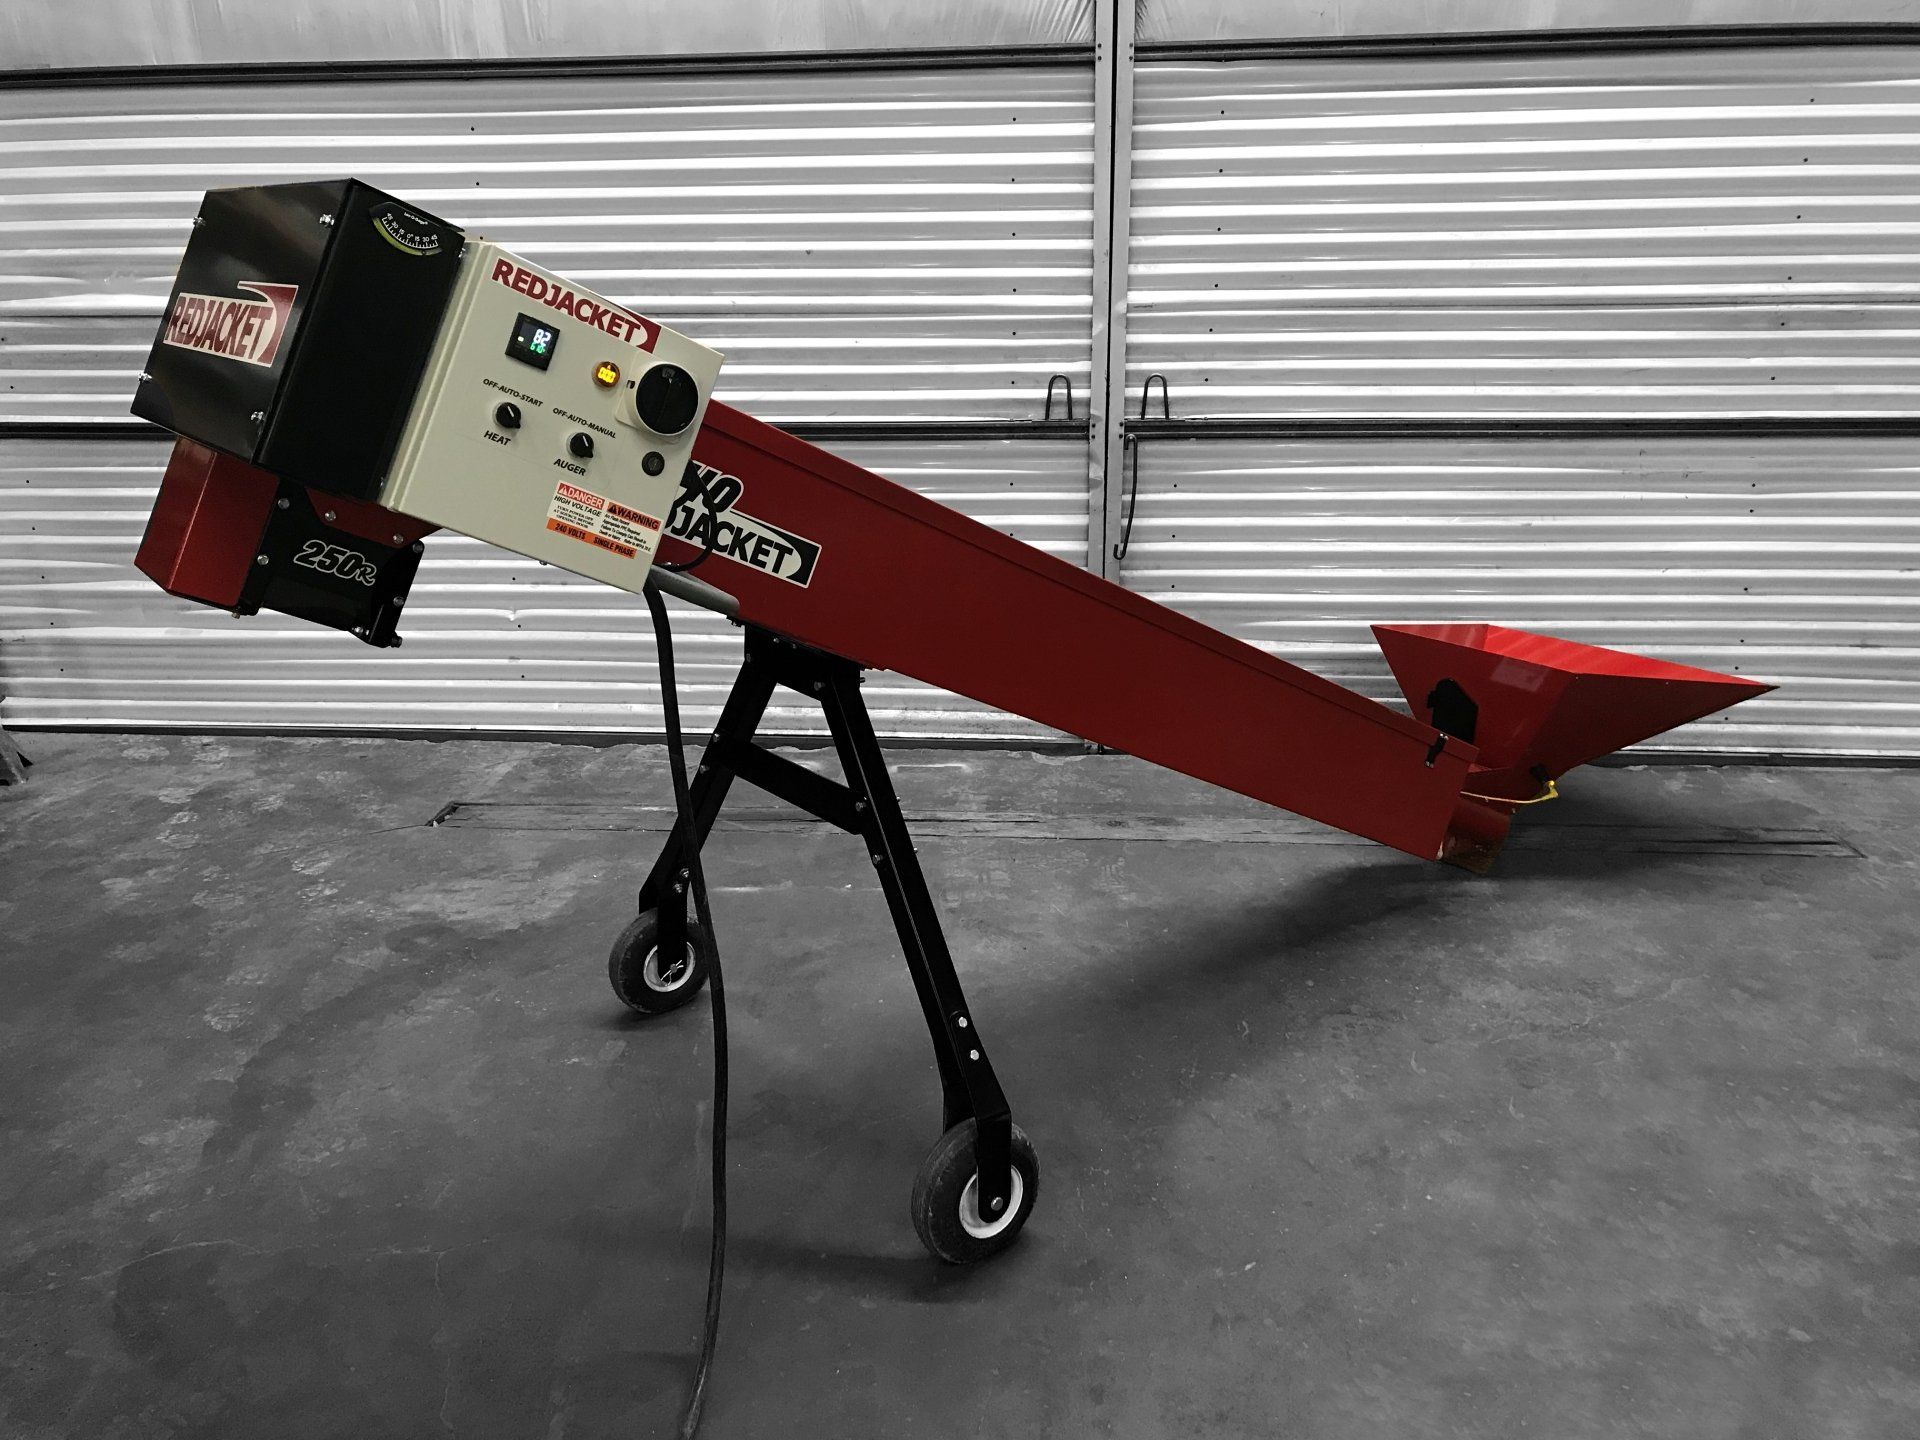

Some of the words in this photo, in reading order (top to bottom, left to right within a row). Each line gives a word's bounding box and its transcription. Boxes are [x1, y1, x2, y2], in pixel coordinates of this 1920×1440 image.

[391, 221, 399, 229] 30
[491, 257, 642, 344] REDJACKET
[165, 296, 274, 360] REDJACKET
[533, 328, 552, 347] 82
[482, 378, 544, 408] OFF-AUTO-START
[552, 407, 617, 440] OFF-AUTO-MANUAL
[483, 430, 512, 447] HEAT
[553, 458, 587, 477] AUGER
[553, 495, 572, 506] HIGH
[571, 501, 603, 518] VOLTAGE
[567, 487, 604, 509] DANGER
[617, 507, 660, 531] WARNING
[568, 527, 586, 540] VOLTS
[593, 536, 615, 550] SINGLE
[614, 544, 635, 557] PHASE
[293, 539, 377, 586] 250R
